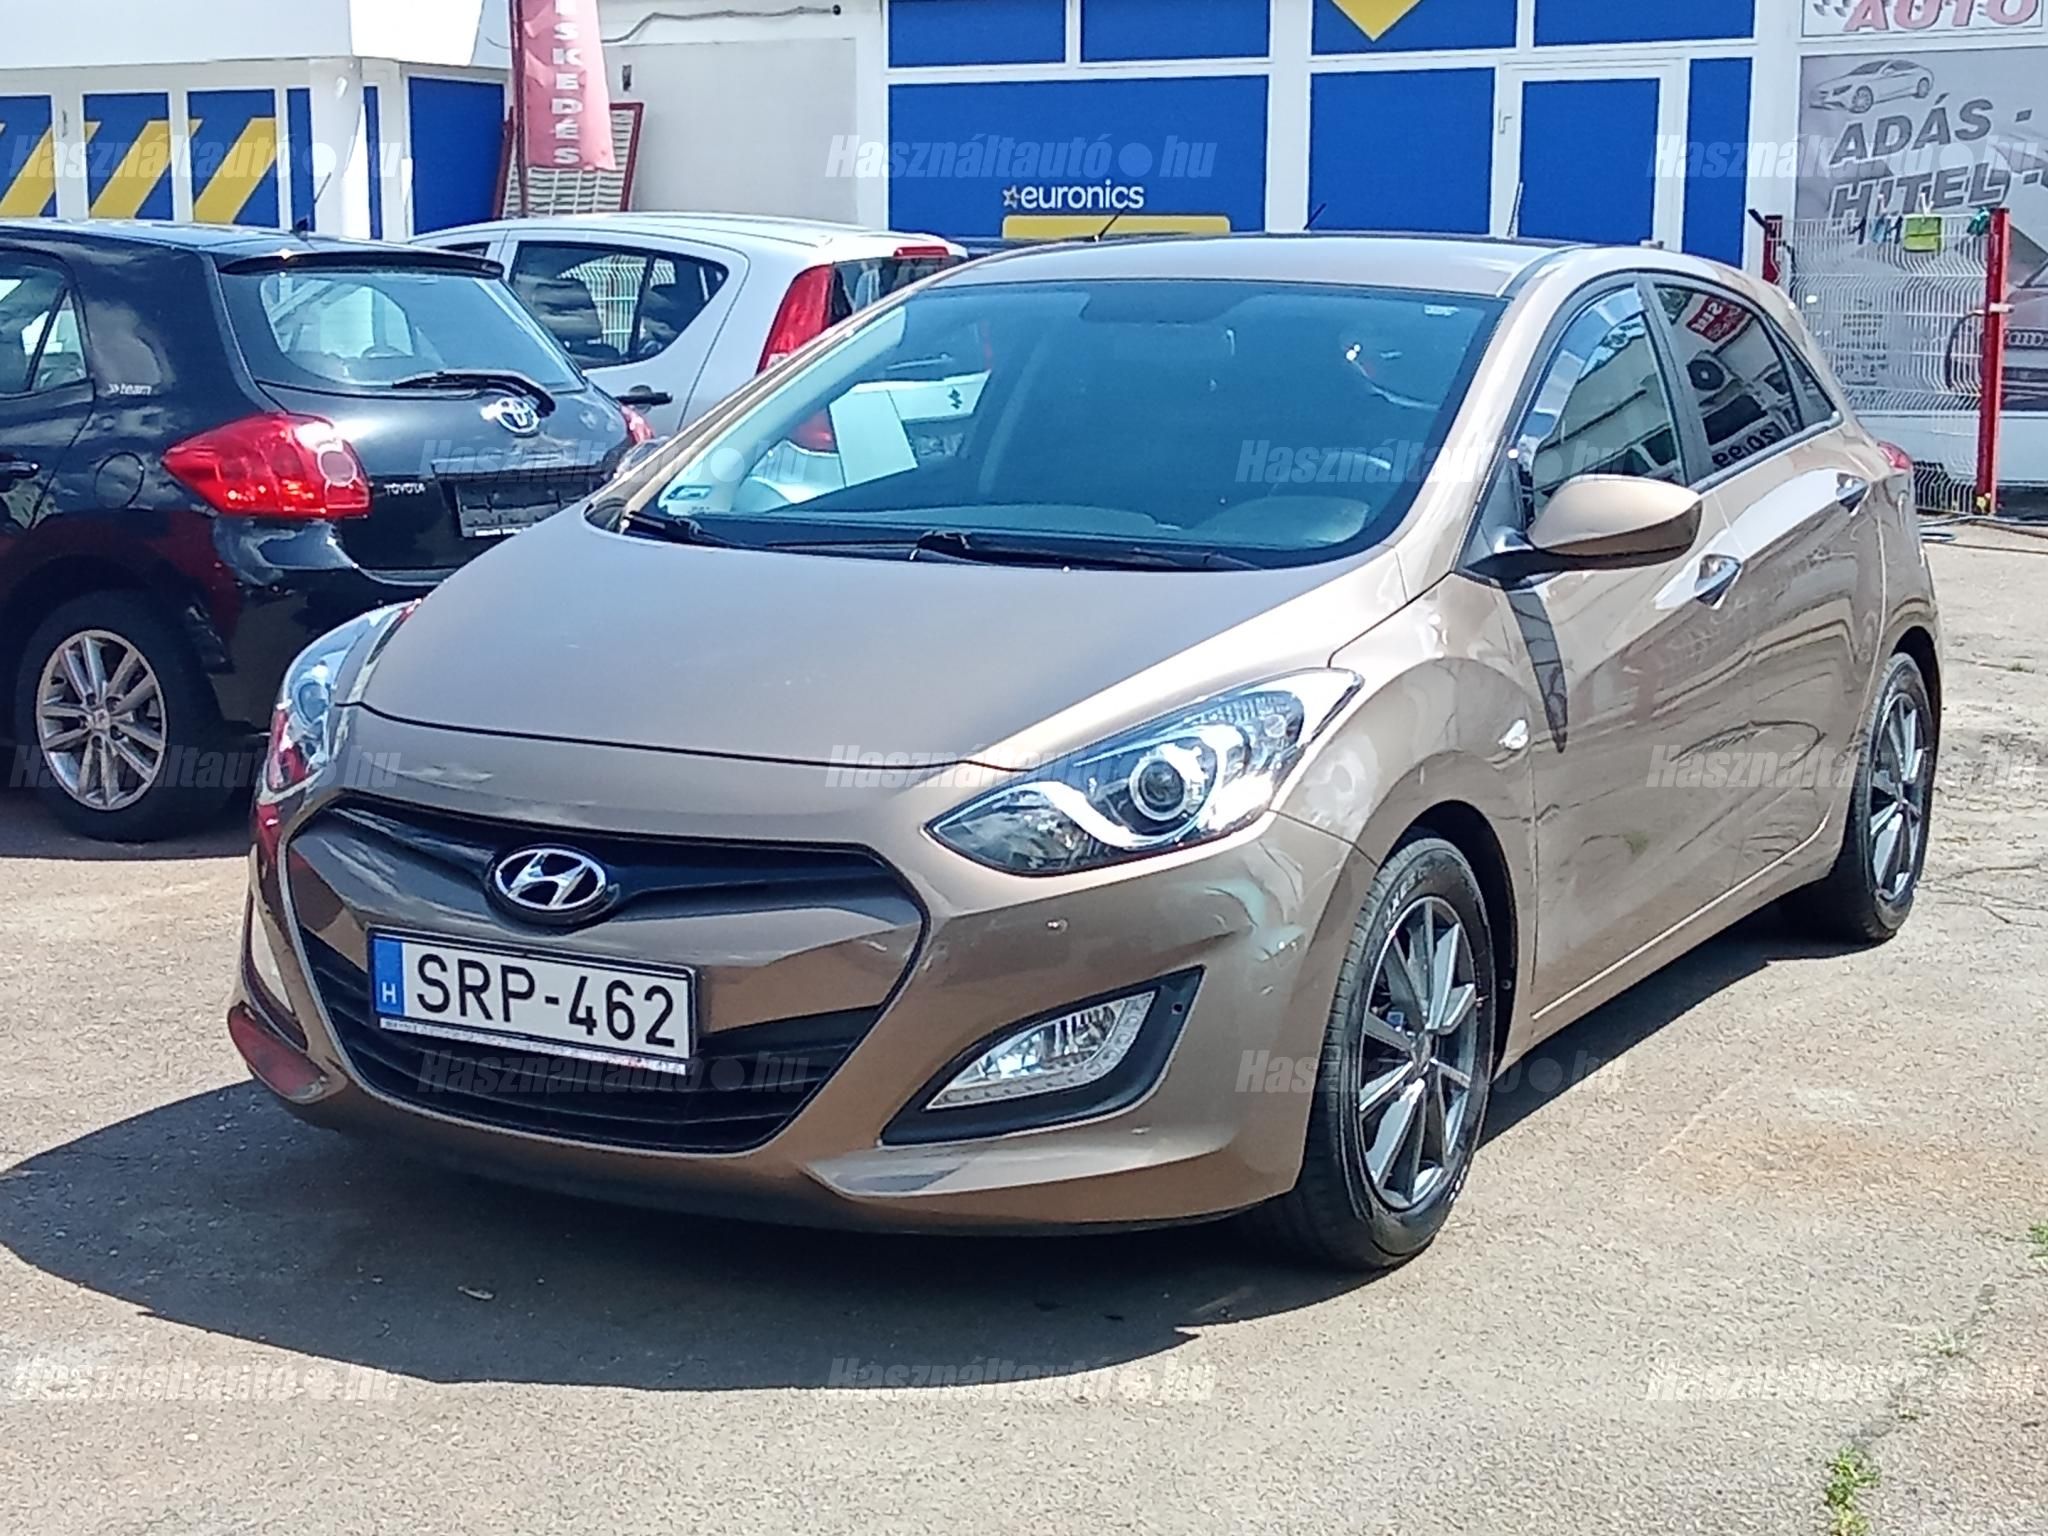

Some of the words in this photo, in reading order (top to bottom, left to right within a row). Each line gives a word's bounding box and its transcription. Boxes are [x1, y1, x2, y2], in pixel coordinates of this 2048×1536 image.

[1843, 0, 2039, 32] AUTO
[1829, 92, 1994, 165] ADÁS
[1020, 178, 1145, 209] euronics
[384, 482, 426, 496] TOYOTA
[380, 982, 398, 1004] H
[416, 953, 676, 1048] SRP-462
